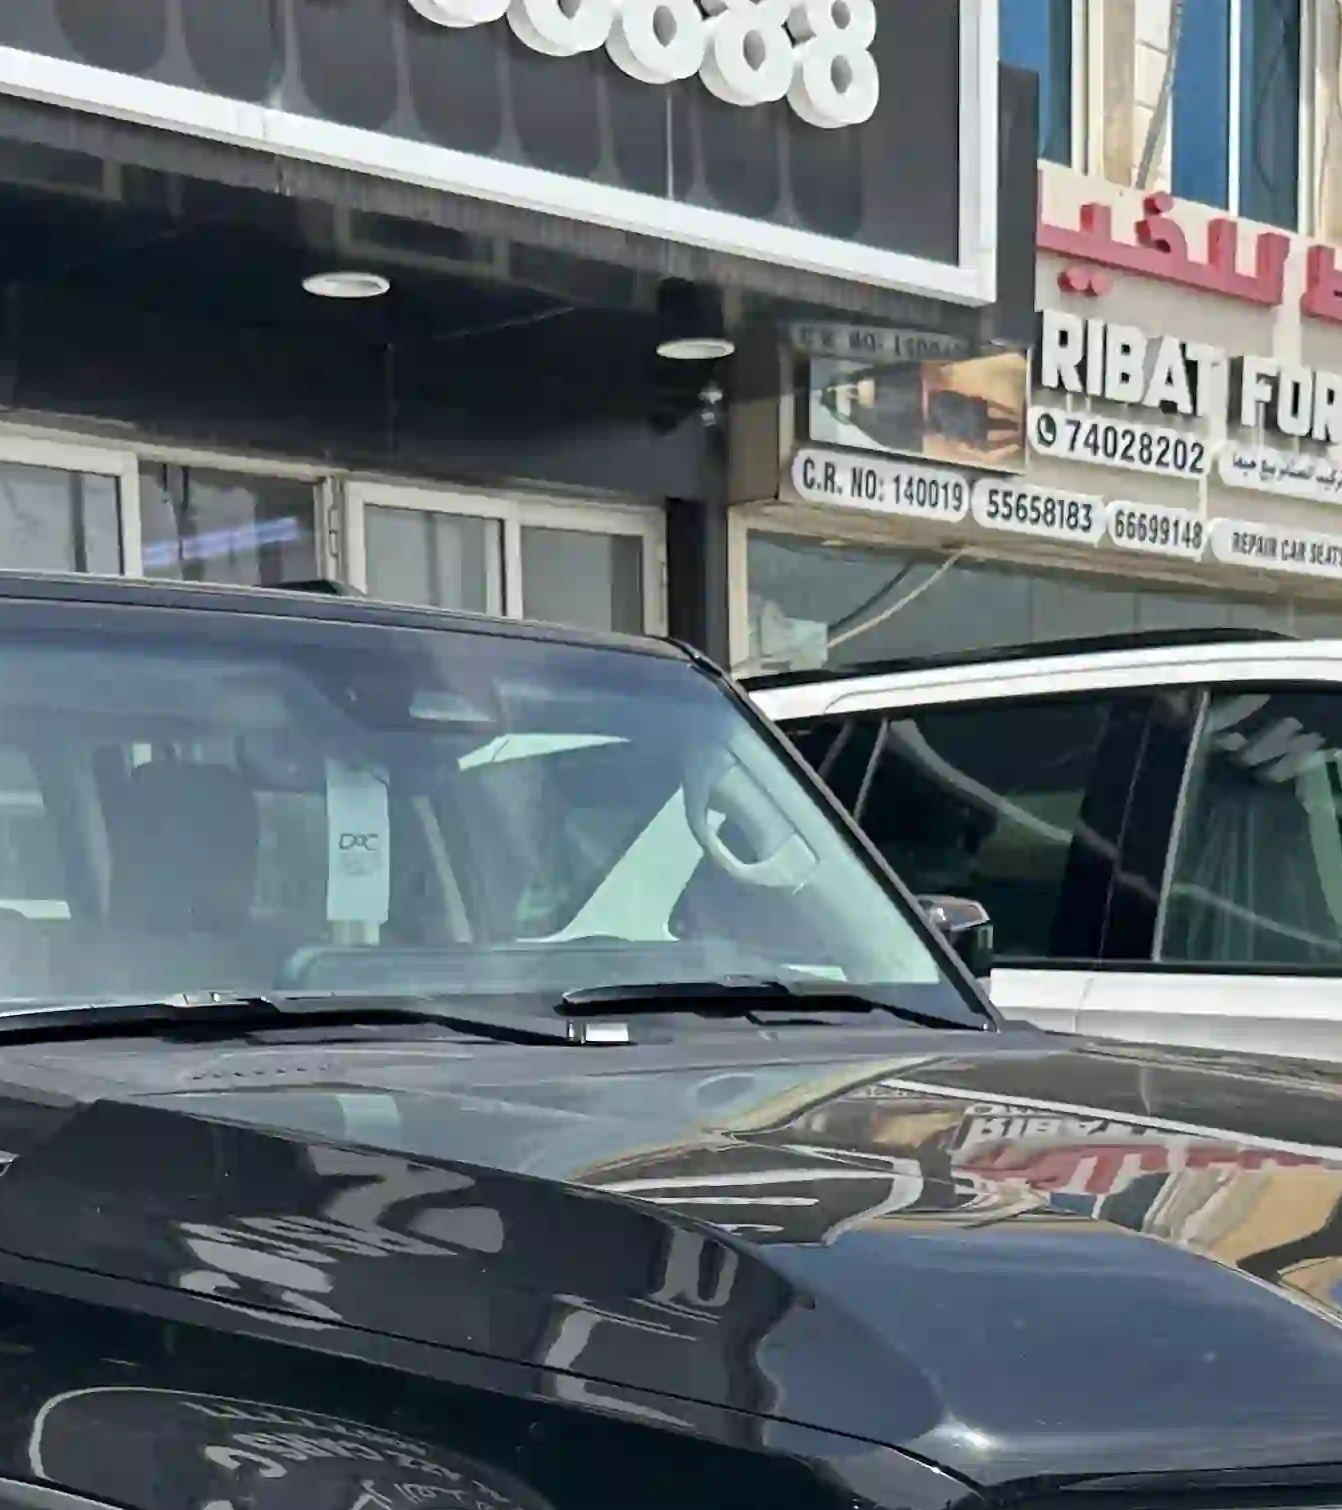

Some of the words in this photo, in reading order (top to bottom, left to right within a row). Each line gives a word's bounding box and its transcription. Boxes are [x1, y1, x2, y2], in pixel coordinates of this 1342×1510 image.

[1039, 307, 1225, 418] RIBAT
[1065, 417, 1206, 475] 74028202
[802, 456, 843, 496] C.R.
[850, 465, 886, 503] NO:
[893, 473, 964, 513] 140019
[986, 488, 1094, 533] 55658183
[1113, 507, 1204, 552] 66699148
[1231, 531, 1278, 557] REPAIR
[1280, 538, 1307, 563] CAR
